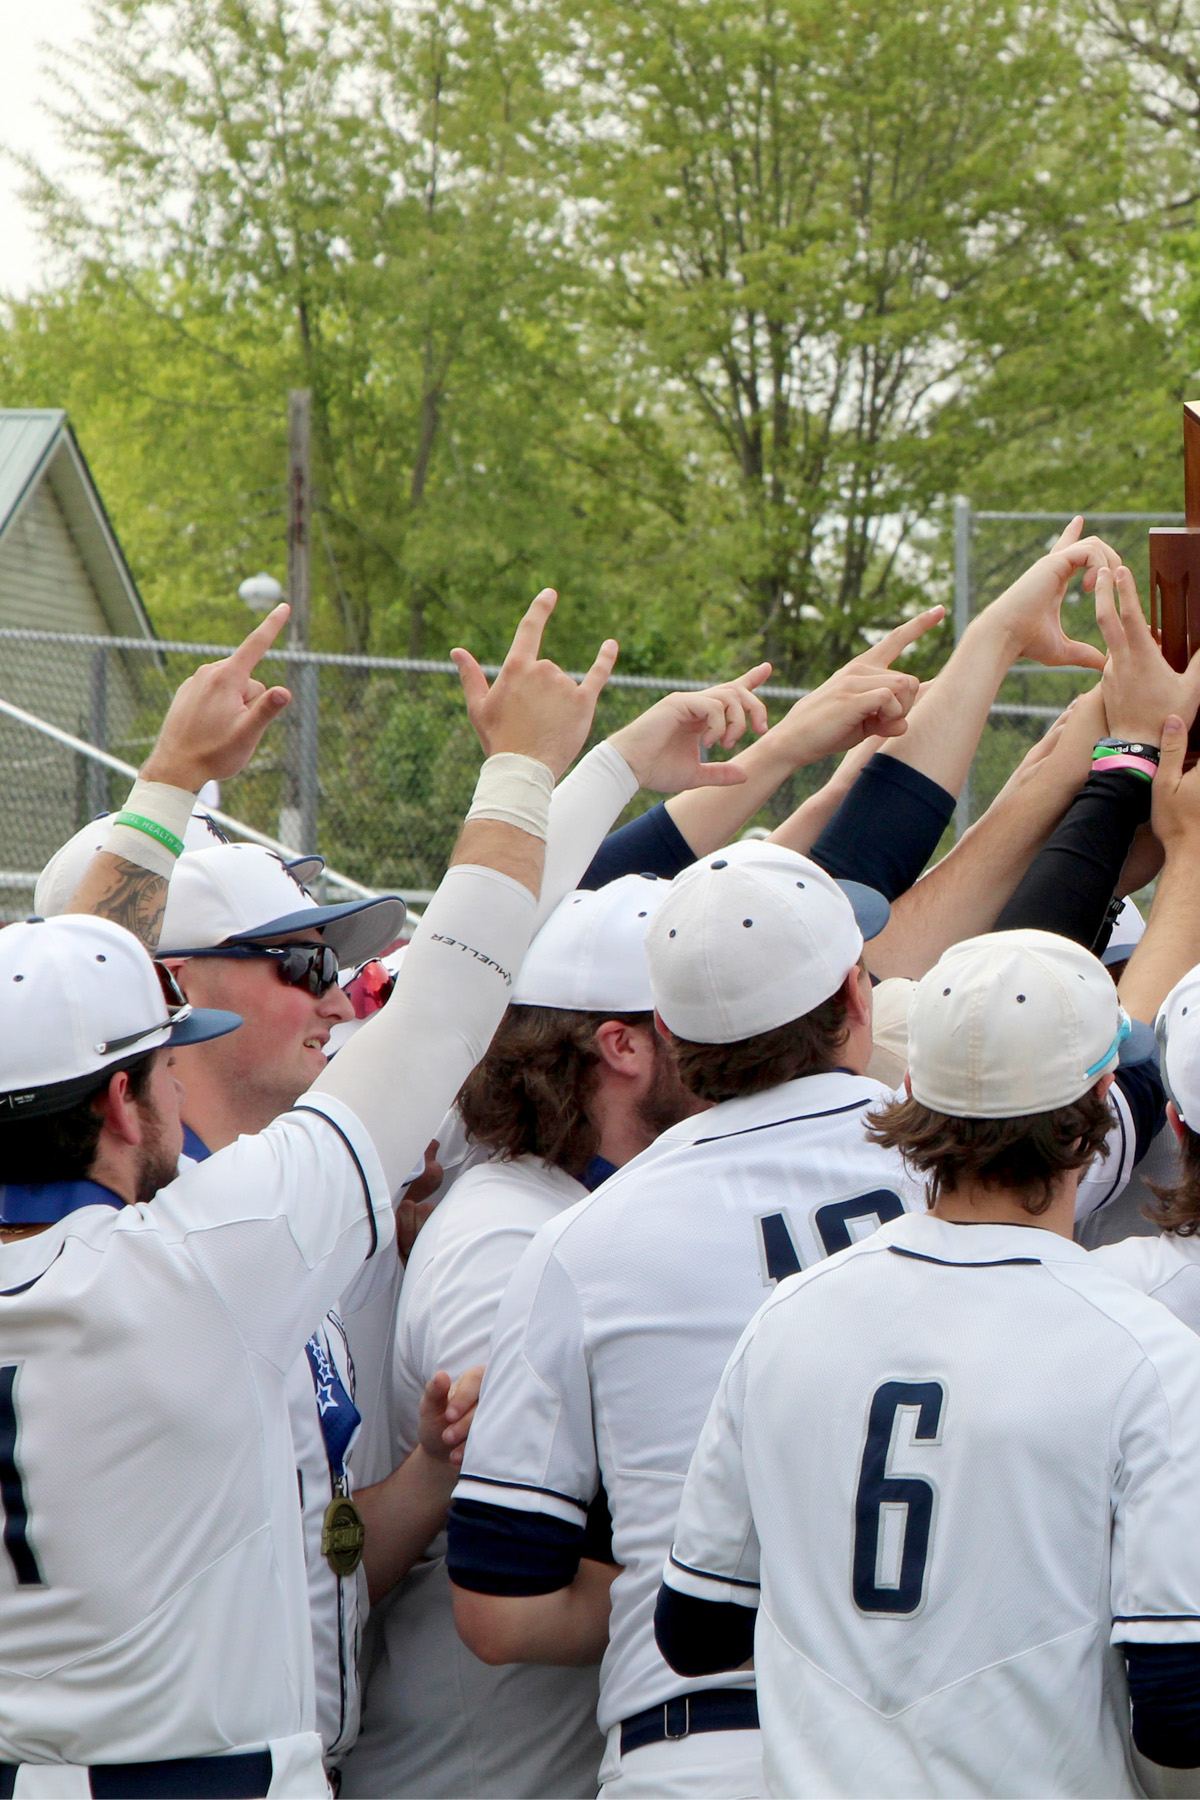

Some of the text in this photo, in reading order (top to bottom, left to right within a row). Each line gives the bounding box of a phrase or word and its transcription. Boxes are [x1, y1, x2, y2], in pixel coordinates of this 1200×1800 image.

[141, 819, 175, 845] HEALTH
[430, 933, 509, 980] MUELLER
[851, 1377, 949, 1621] 6
